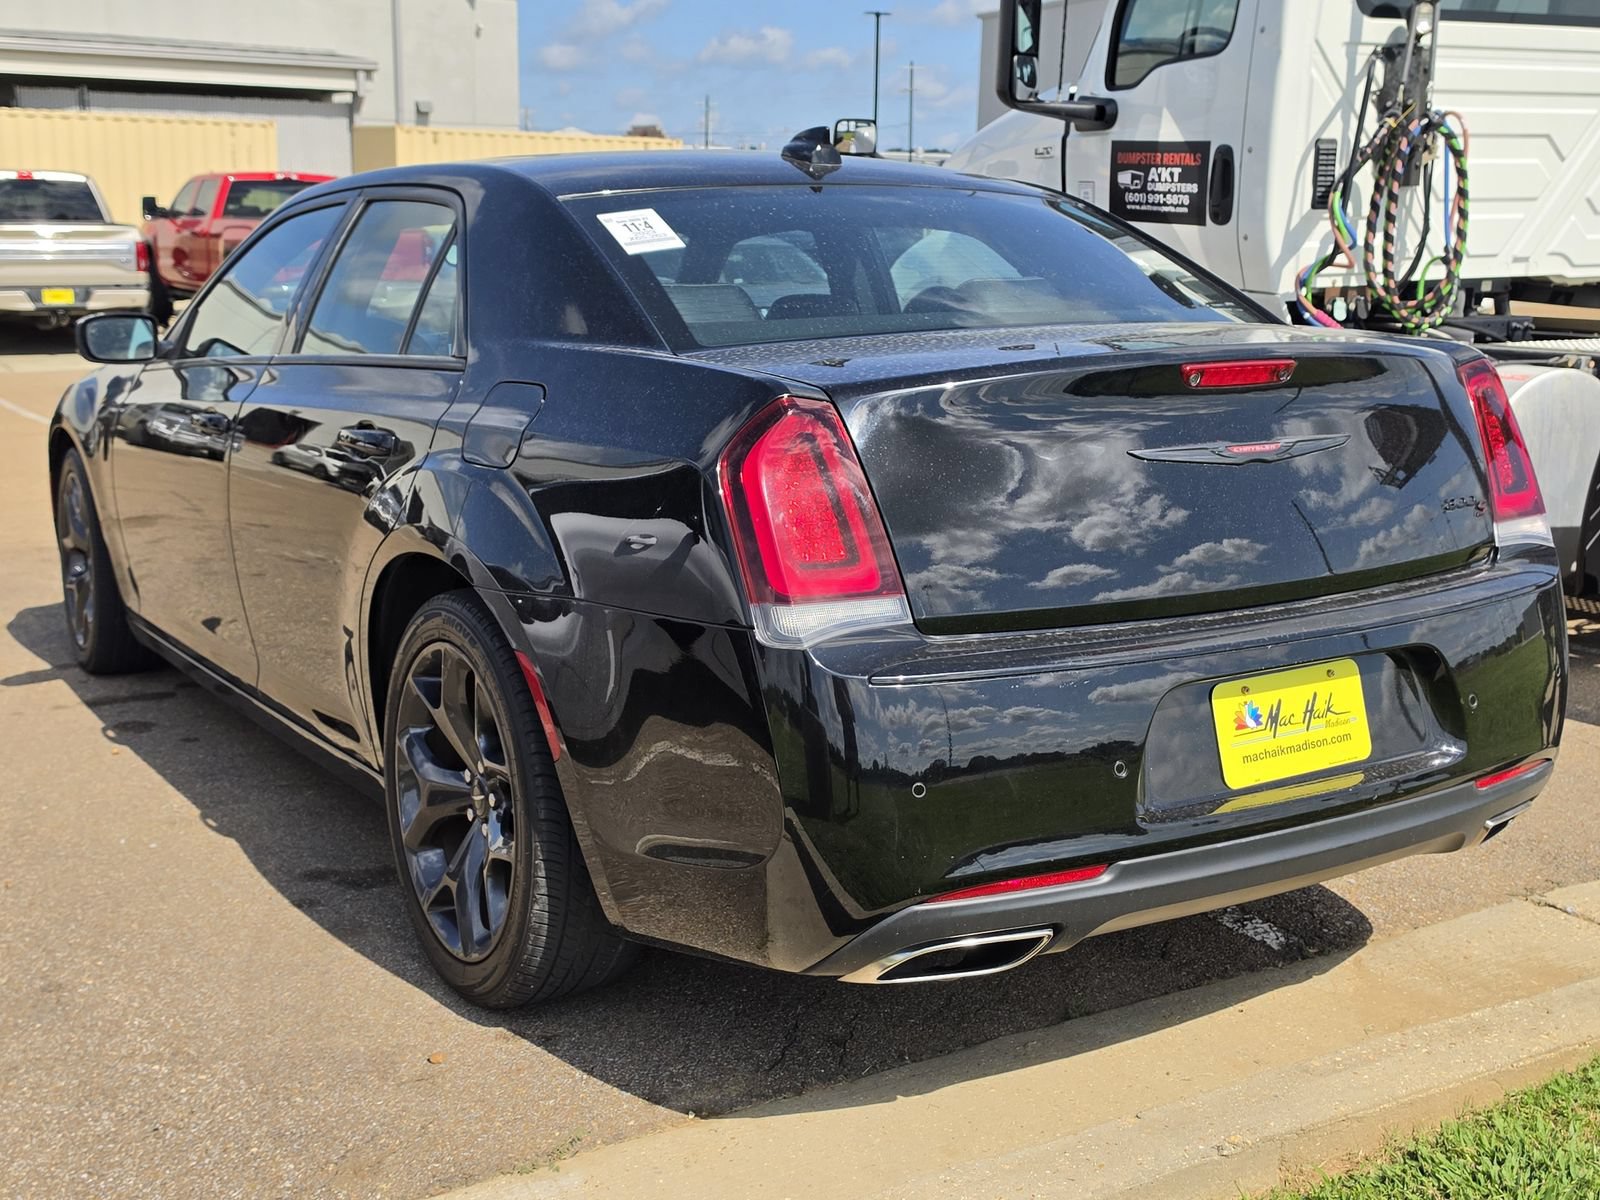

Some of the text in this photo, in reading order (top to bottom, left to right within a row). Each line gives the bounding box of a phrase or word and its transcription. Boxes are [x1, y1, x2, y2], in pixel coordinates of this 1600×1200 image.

[1117, 152, 1202, 166] DUMPSTER RENTALS
[1147, 183, 1198, 193] DUMPSTERS
[1125, 192, 1146, 203] (601)
[1230, 444, 1280, 452] CHRYSLER
[1263, 691, 1351, 739] Mac Haik
[1324, 718, 1352, 729] Madison
[1242, 732, 1352, 765] machaikmadison.com
